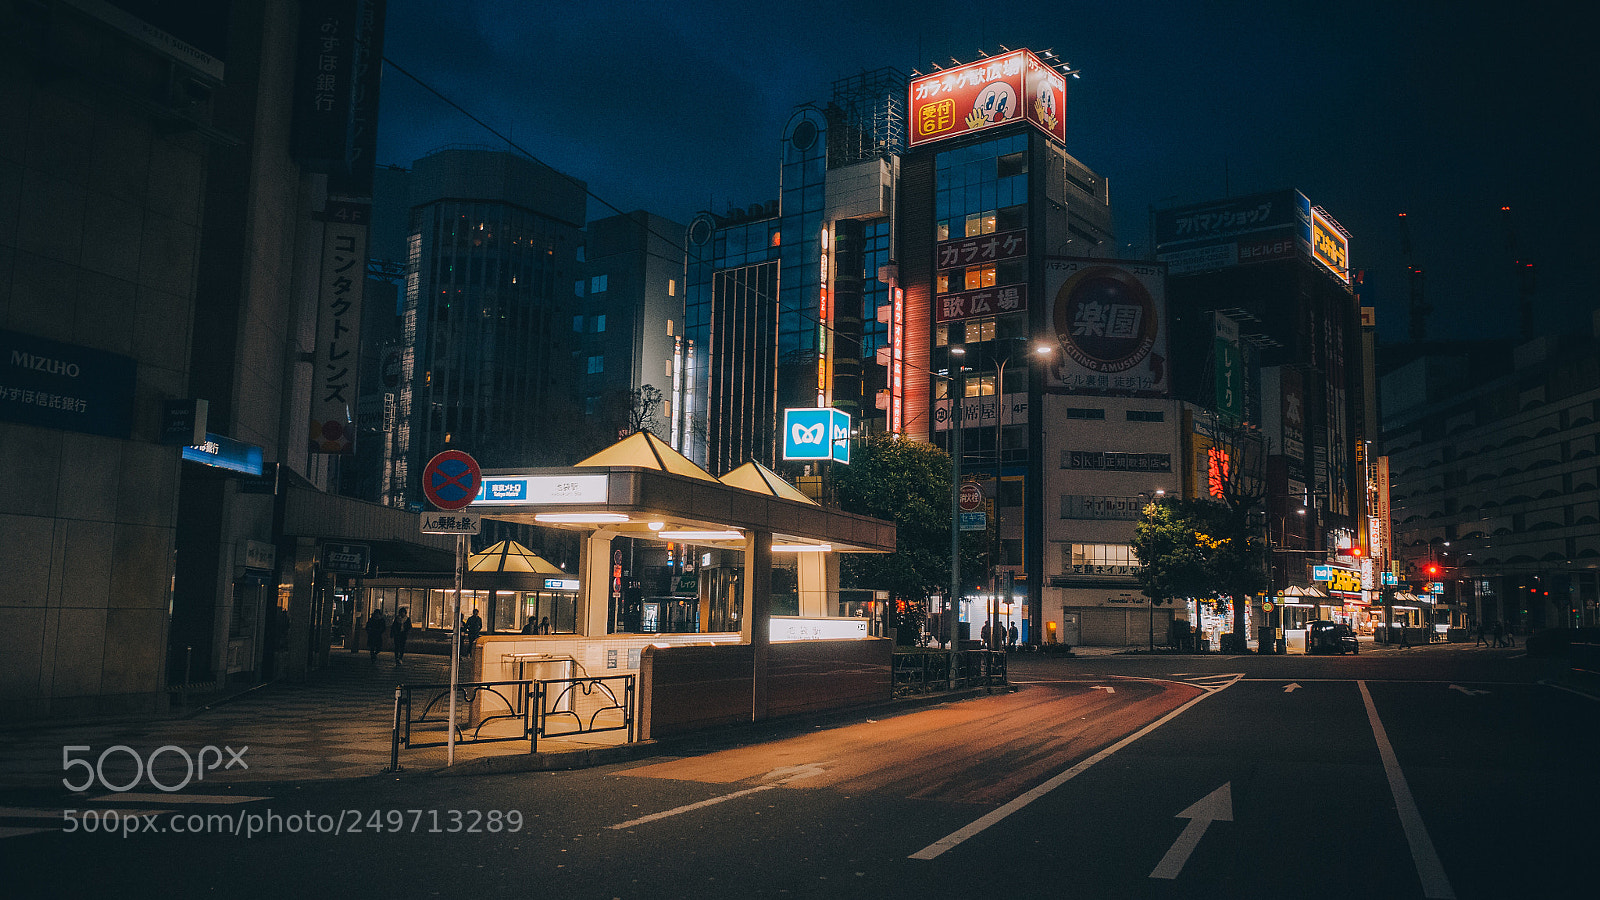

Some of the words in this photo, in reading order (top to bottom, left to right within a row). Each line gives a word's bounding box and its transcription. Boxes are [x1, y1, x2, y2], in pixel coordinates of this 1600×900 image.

[915, 56, 1022, 100] カラオケ歌広場
[922, 102, 951, 119] 受付
[923, 116, 950, 132] 6F
[334, 207, 362, 222] 4F
[1175, 202, 1273, 235] アパマンショップ
[940, 234, 1023, 267] カラオケ
[1239, 241, 1293, 259] 当ビル6F
[1046, 262, 1077, 271] パチンコ
[1133, 267, 1164, 276] スロット
[942, 287, 1020, 318] 歌広場
[324, 235, 356, 404] コンタクトレンズ
[1072, 301, 1144, 339] 楽園
[1058, 333, 1098, 370] EXCITING
[1100, 338, 1154, 372] AMUSEMENT
[10, 350, 81, 377] MIZUHO
[1062, 374, 1110, 387] ビル裏側
[1113, 375, 1153, 389] 徒歩1分
[1224, 347, 1234, 408] レイク
[1013, 403, 1028, 414] 4F
[491, 484, 521, 493] 東京メトロ
[423, 516, 477, 531] 人の乗降を除く
[680, 580, 696, 589] レイク
